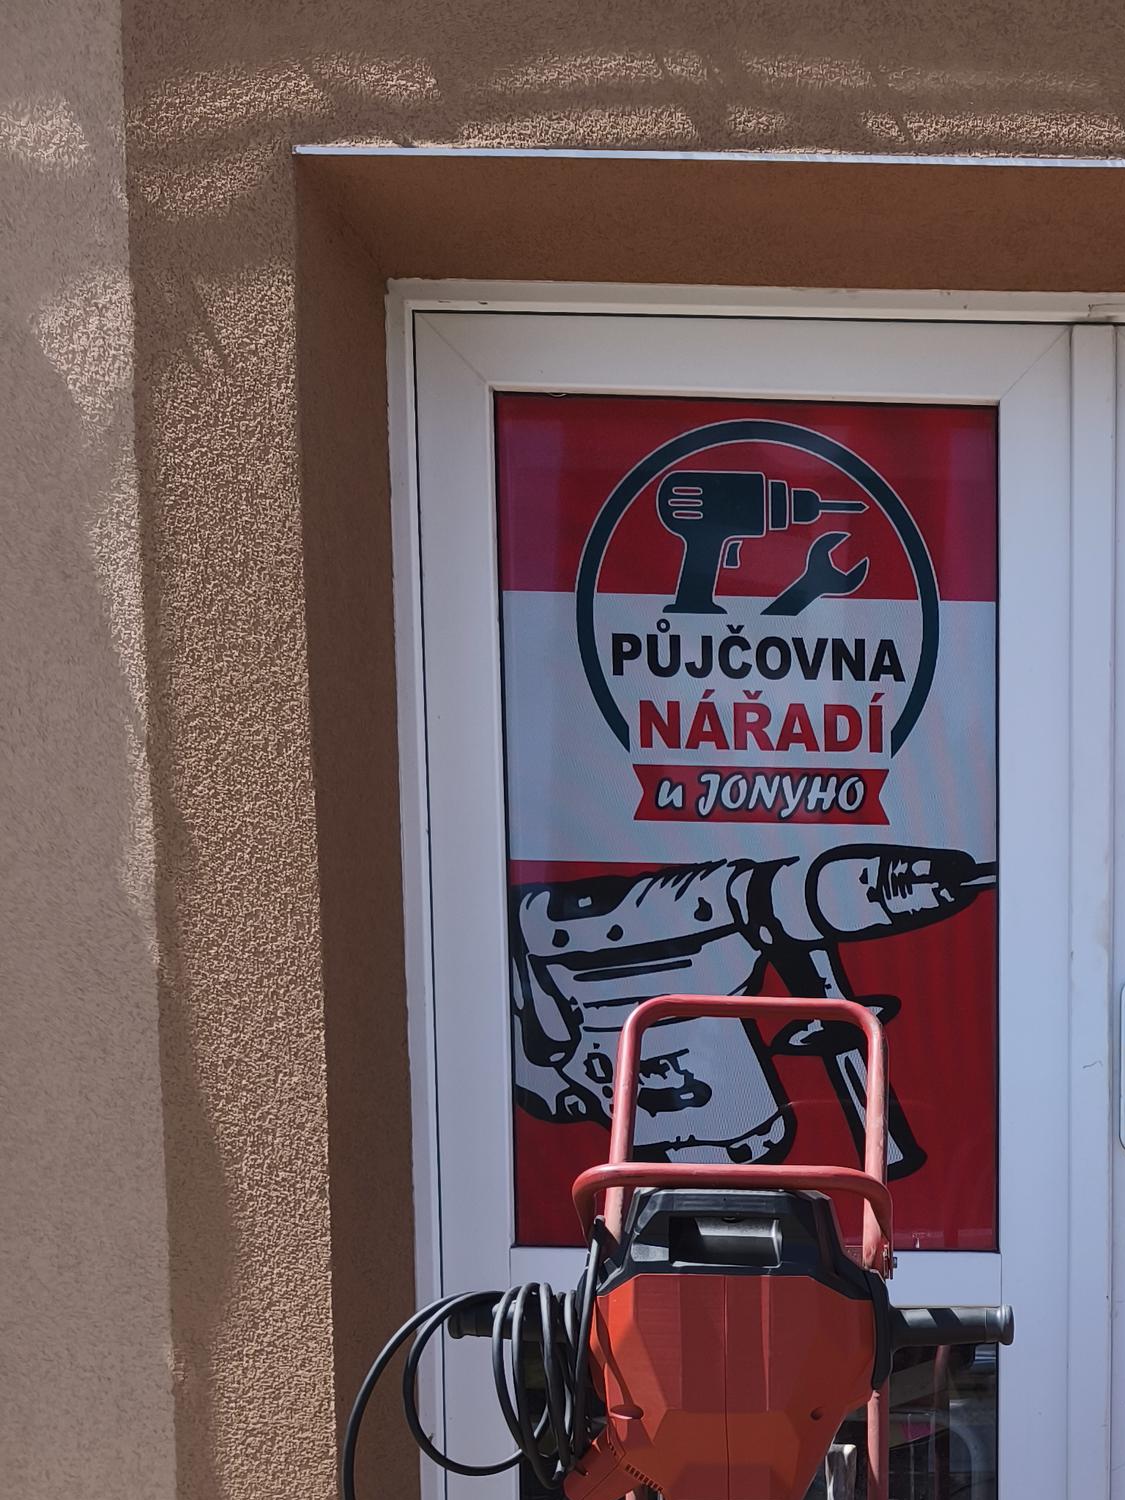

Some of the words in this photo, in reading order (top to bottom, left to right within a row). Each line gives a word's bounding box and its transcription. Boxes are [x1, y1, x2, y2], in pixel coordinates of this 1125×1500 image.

[611, 619, 906, 682] PŮJČOVNA
[639, 689, 885, 754] NÁŘADÍ
[656, 777, 684, 809] u
[699, 773, 865, 817] JONYHO
